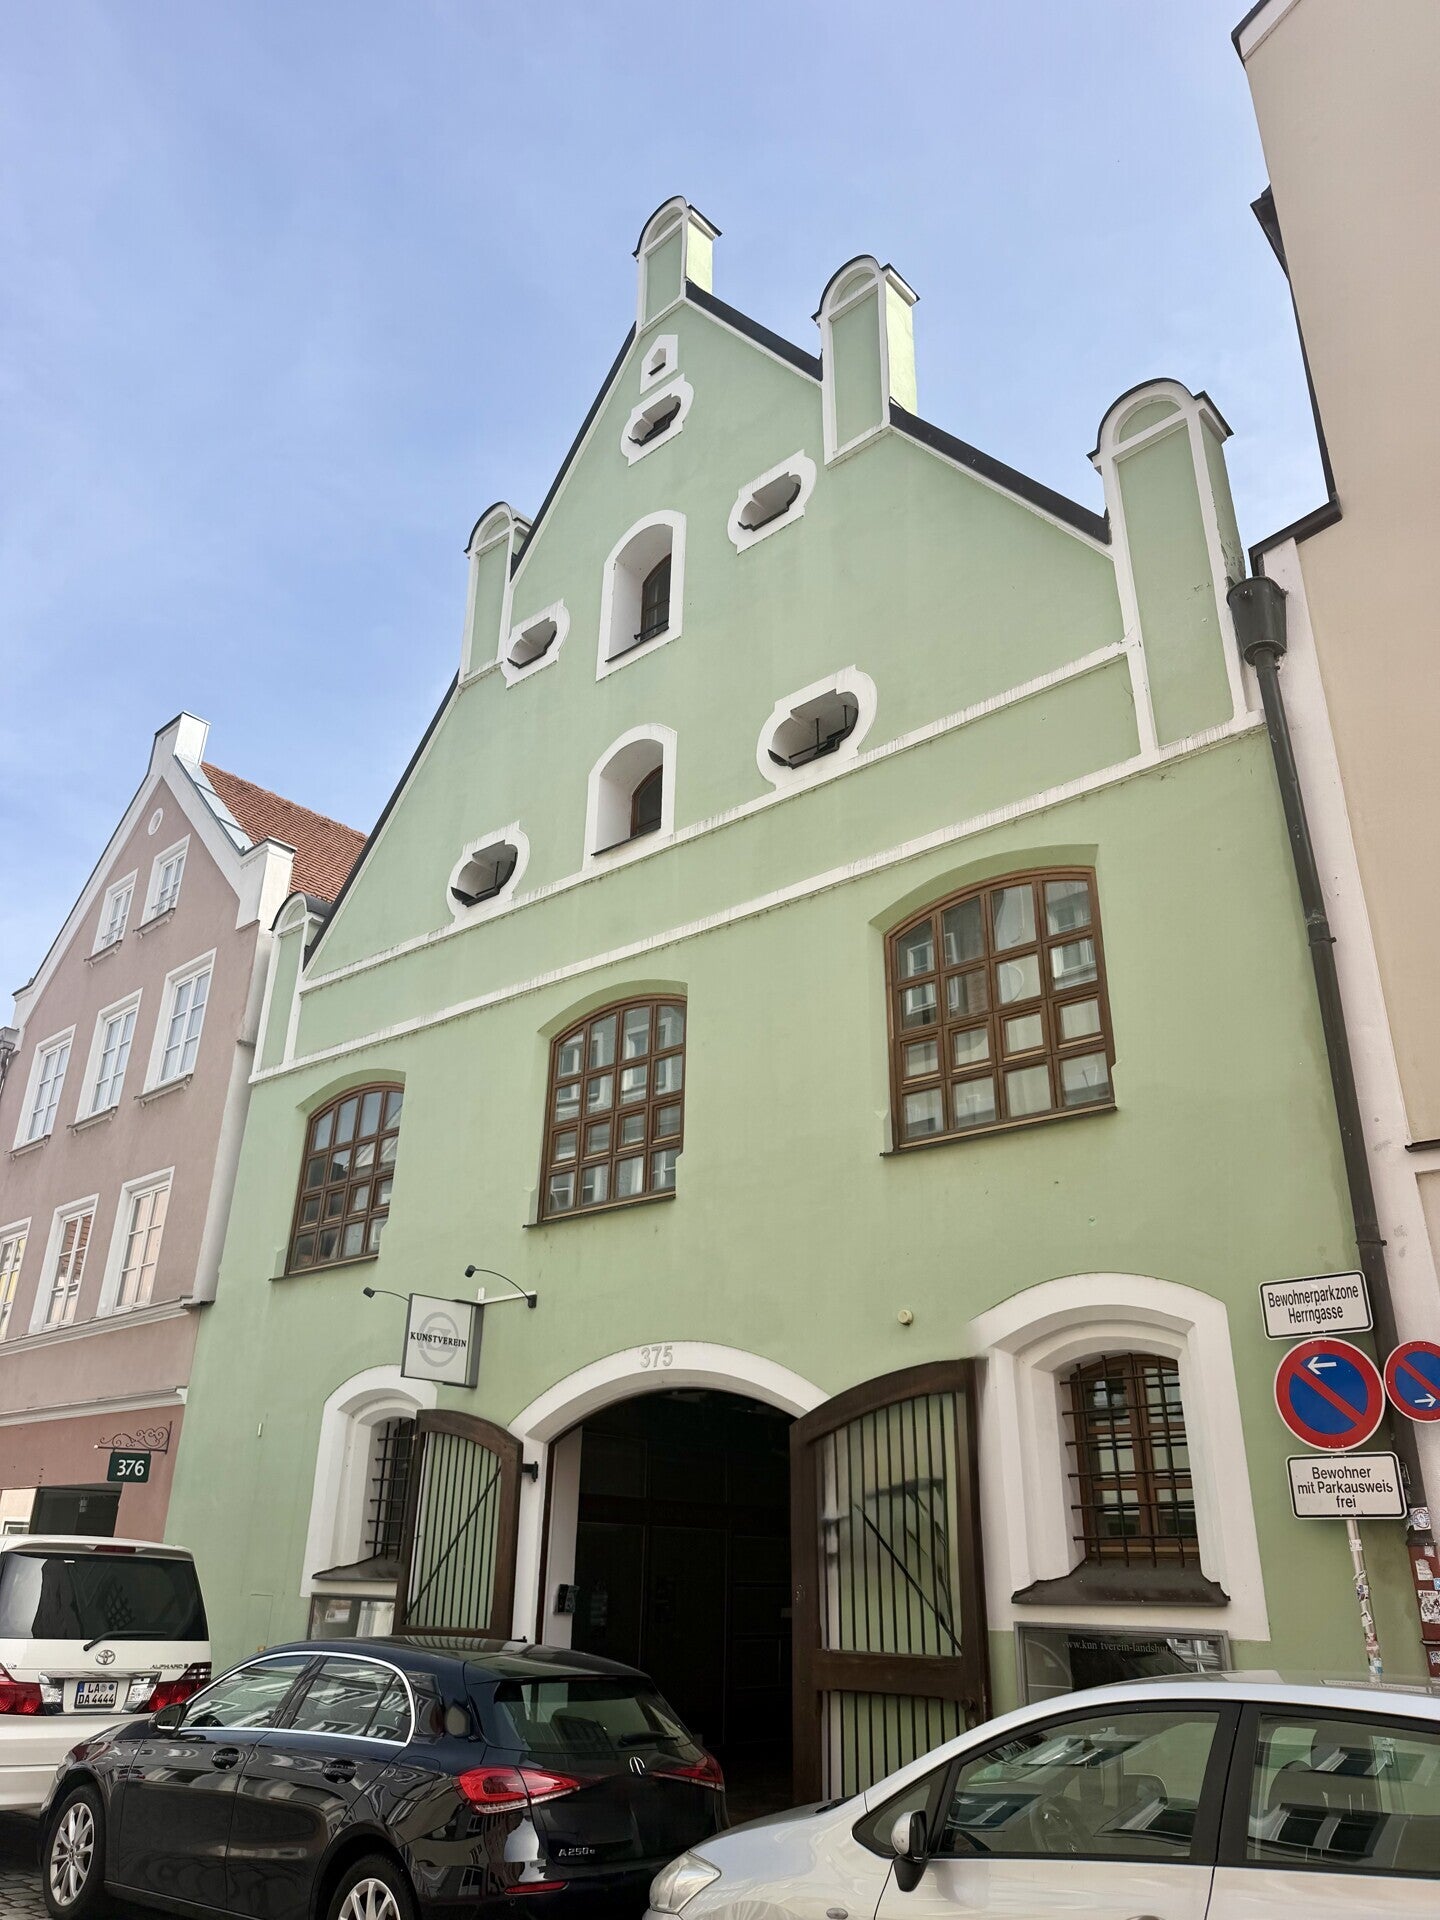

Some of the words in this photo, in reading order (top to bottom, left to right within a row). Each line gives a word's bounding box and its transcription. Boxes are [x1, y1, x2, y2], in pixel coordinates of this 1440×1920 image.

[1267, 1284, 1359, 1308] Bewohnerparkzone
[1287, 1304, 1344, 1324] Herrngasse
[410, 1331, 467, 1348] KUNSTVEREIN
[640, 1345, 673, 1368] 375
[116, 1459, 145, 1476] 376
[1311, 1466, 1371, 1480] Bewohner
[1297, 1481, 1316, 1494] mit
[1317, 1478, 1394, 1494] Parkausweis
[1336, 1495, 1357, 1508] frei
[88, 1683, 100, 1693] LA
[78, 1694, 90, 1704] DA
[91, 1693, 114, 1704] 4444
